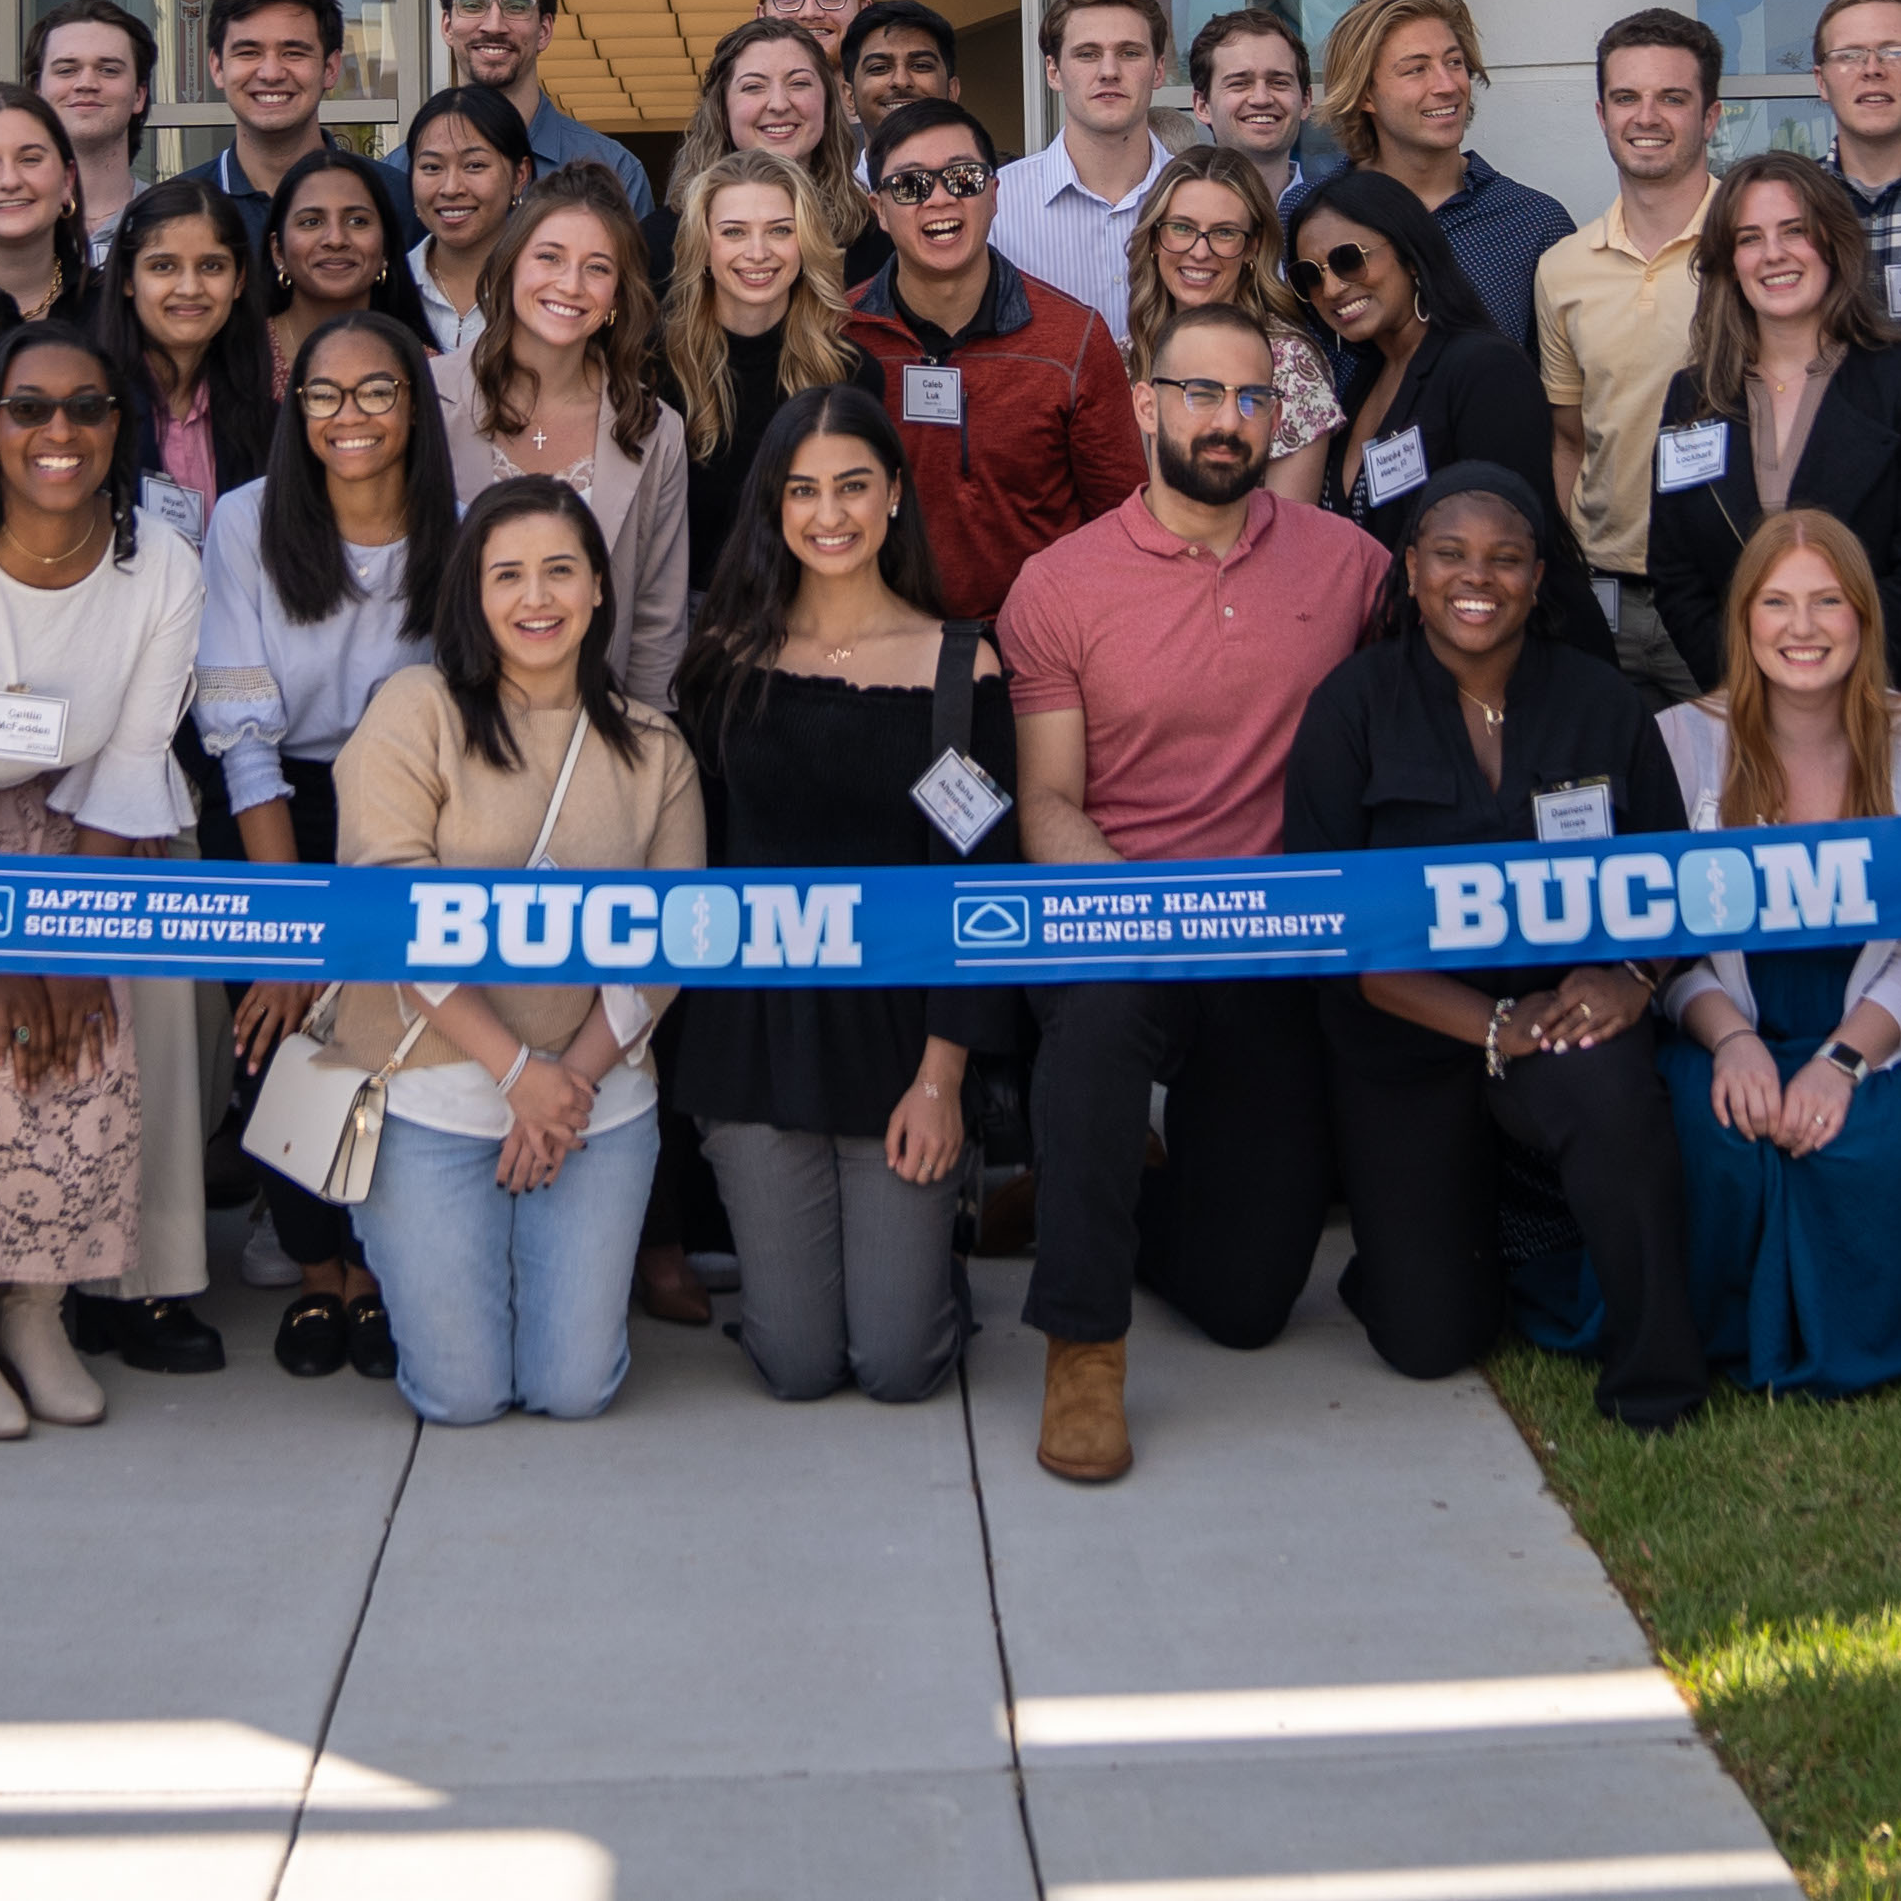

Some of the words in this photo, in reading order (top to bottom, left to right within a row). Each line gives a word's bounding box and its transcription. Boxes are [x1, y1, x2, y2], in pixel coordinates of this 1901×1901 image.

[923, 379, 943, 388] Caleb
[8, 708, 42, 720] Caitlin
[26, 889, 137, 911] BAPTIST
[147, 894, 249, 915] HEALTH
[1042, 895, 1152, 917] BAPTIST
[1163, 891, 1266, 913] HEALTH
[1424, 838, 1878, 950] BUCOM
[24, 916, 153, 939] SCIENCES
[161, 919, 325, 944] UNIVERSITY
[406, 882, 862, 968] BUCOM
[1043, 919, 1172, 943] SCIENCES
[1181, 914, 1345, 939] UNIVERSITY
